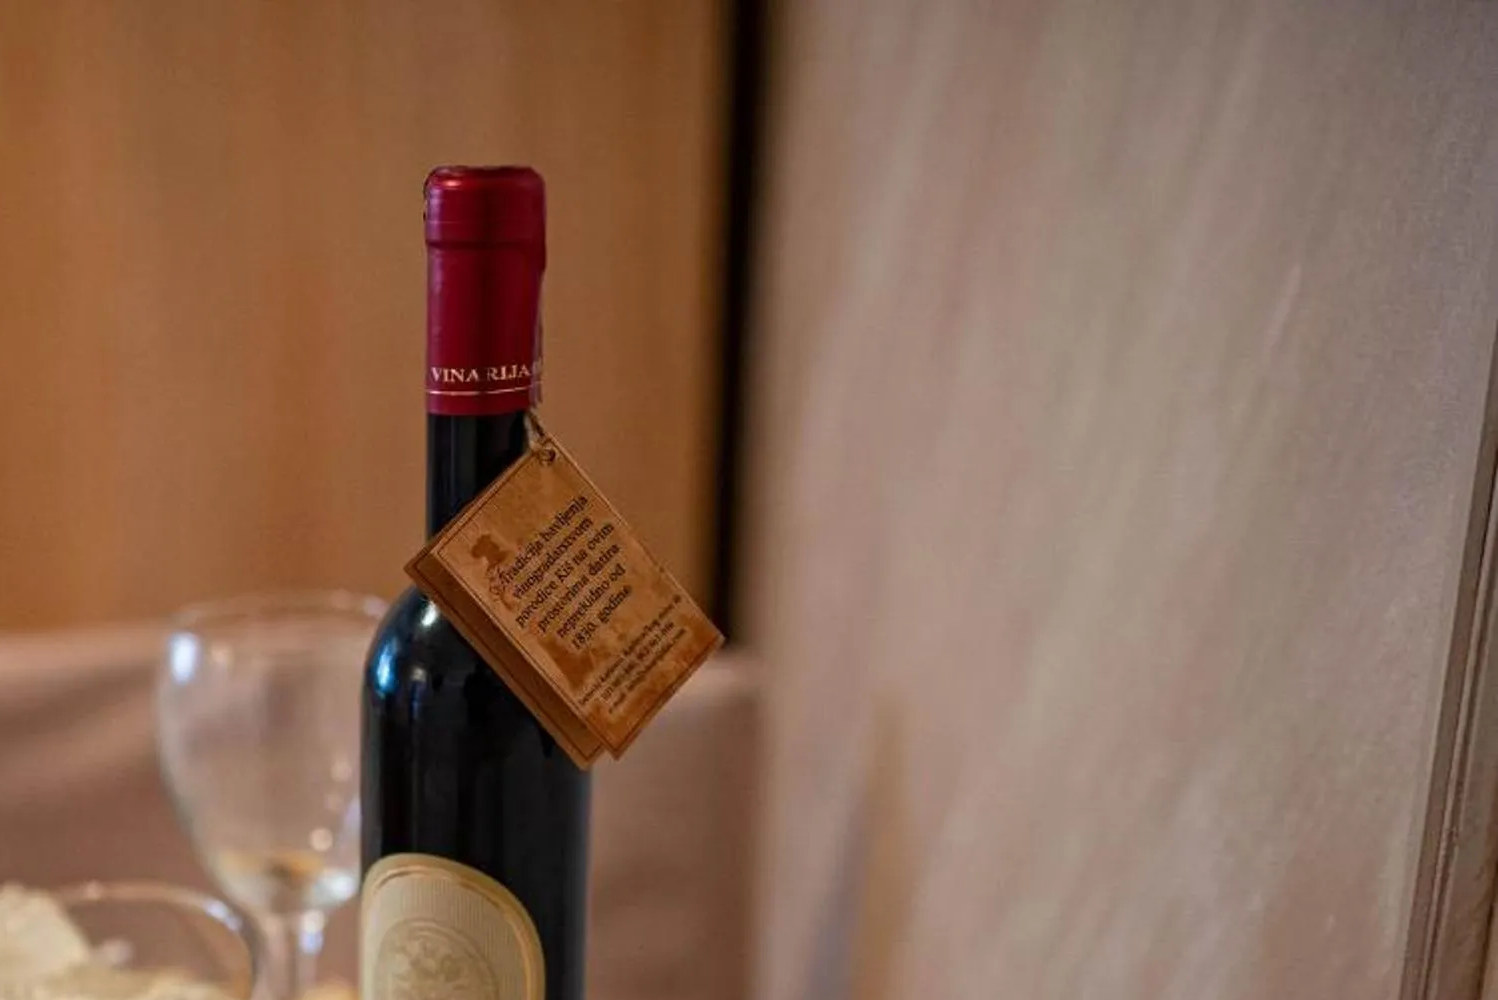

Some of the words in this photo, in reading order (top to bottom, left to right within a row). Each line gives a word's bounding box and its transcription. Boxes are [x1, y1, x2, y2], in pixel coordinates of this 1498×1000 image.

[515, 581, 558, 627] porodice
[587, 523, 614, 550] ovim
[537, 575, 590, 632] prostorima
